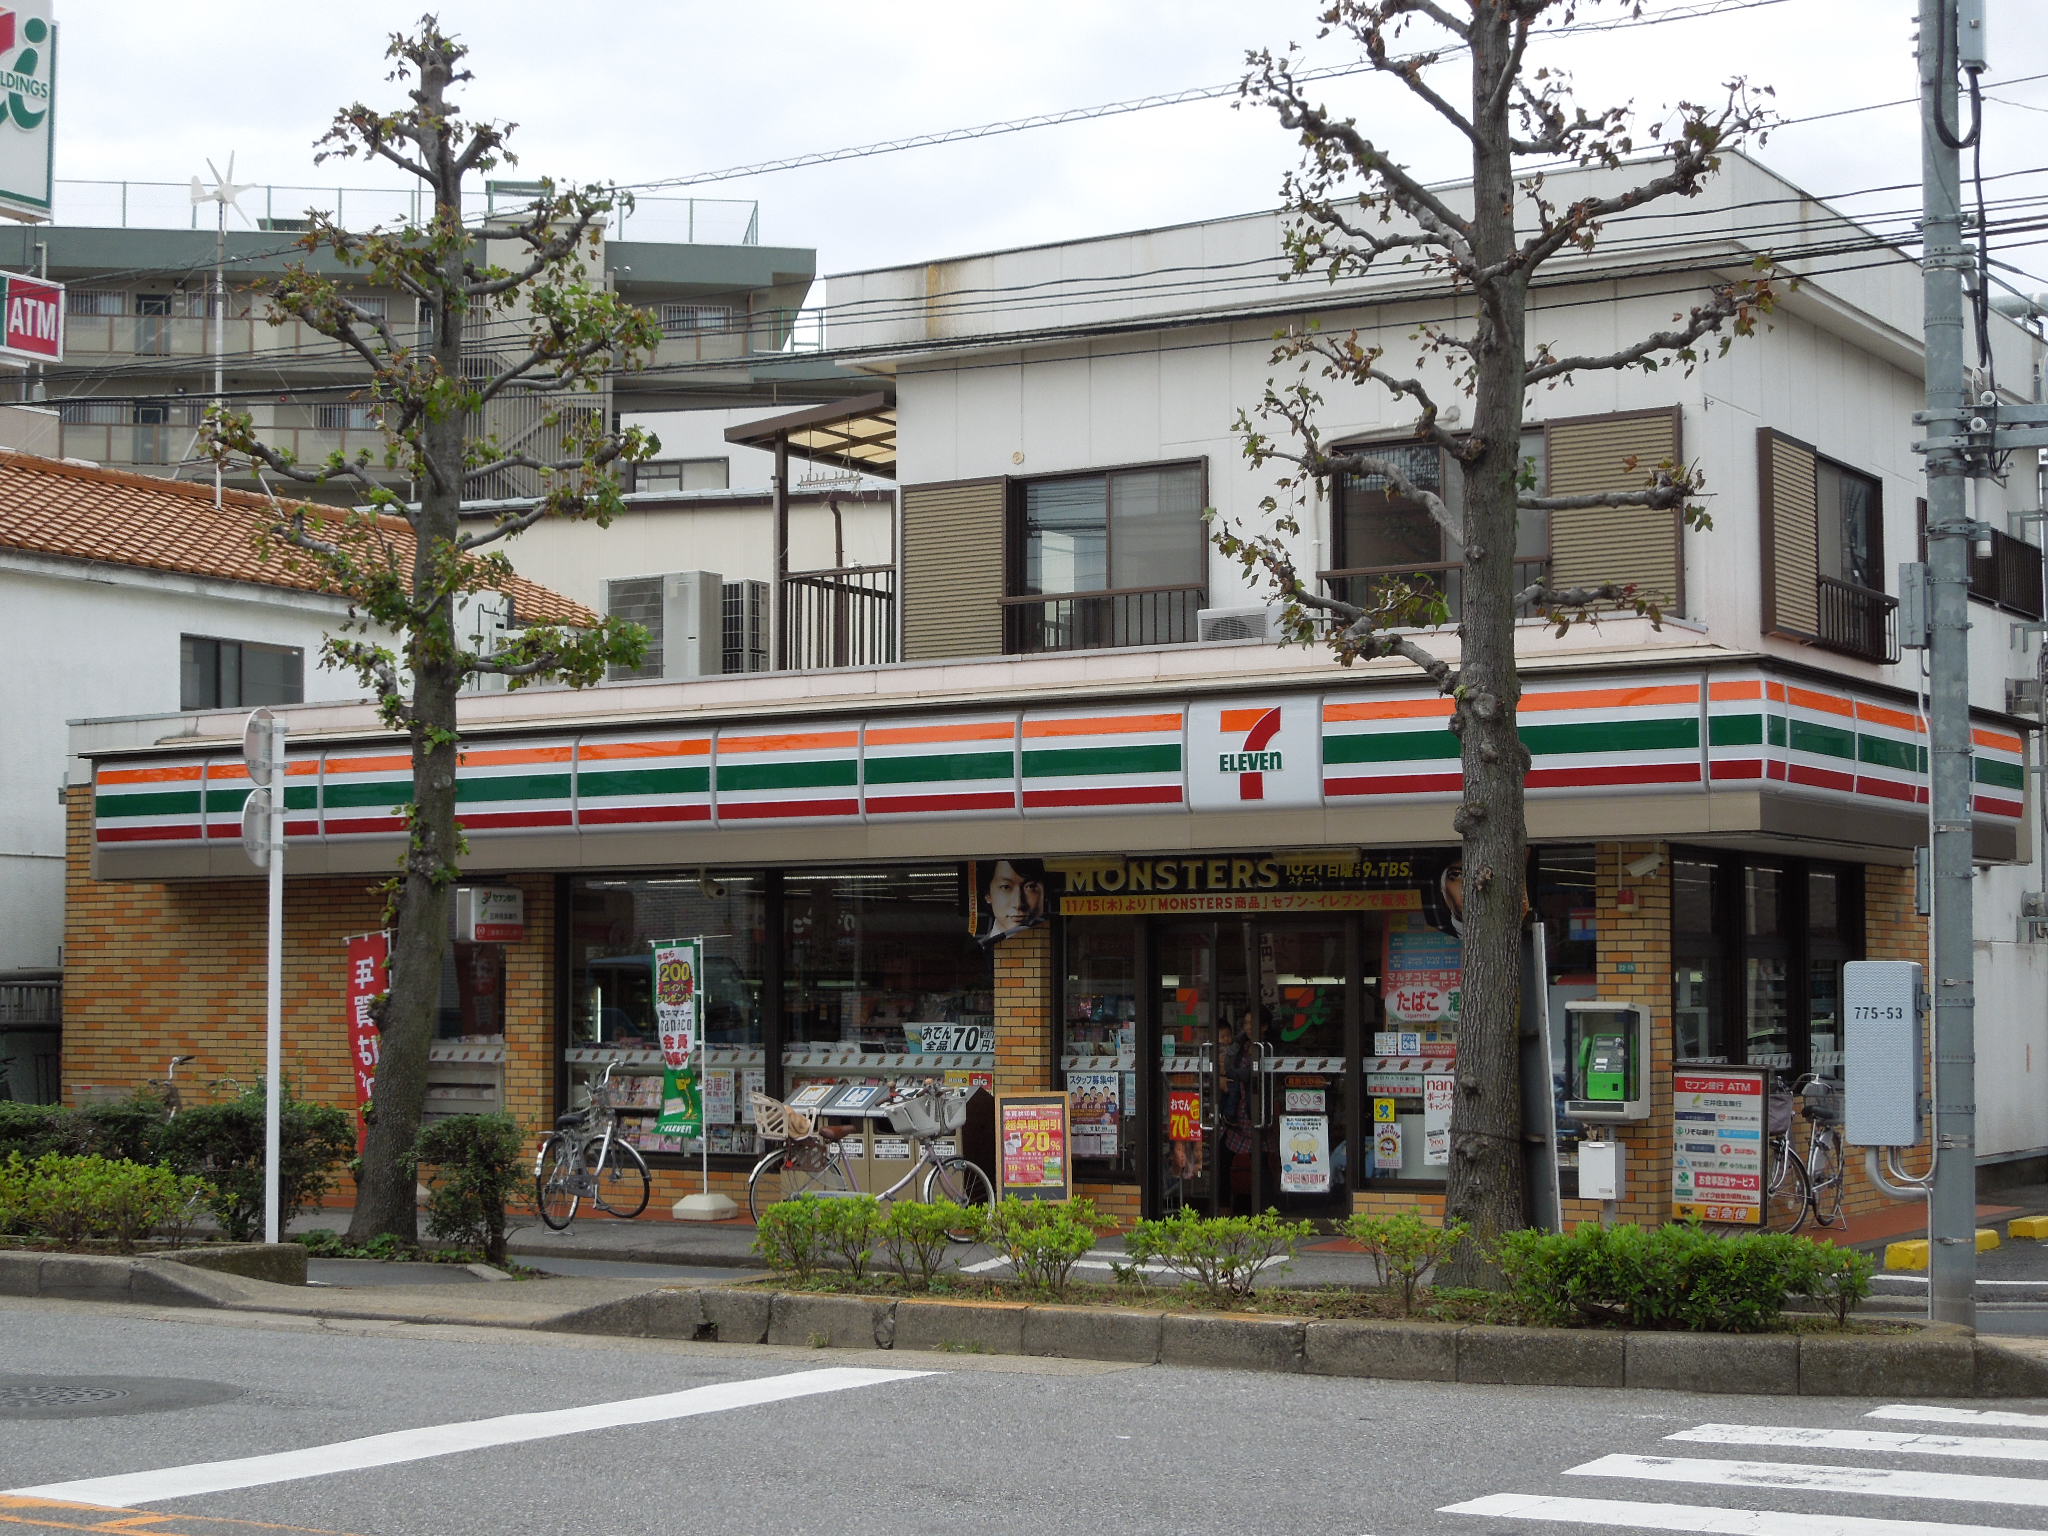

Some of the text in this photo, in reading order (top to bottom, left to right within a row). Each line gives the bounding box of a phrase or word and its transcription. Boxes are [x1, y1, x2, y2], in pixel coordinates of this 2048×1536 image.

[0, 71, 48, 98] LDINGS
[8, 296, 57, 342] ATM
[1220, 706, 1281, 800] 7
[1064, 859, 1280, 892] MONSTERS
[660, 961, 691, 982] 200
[663, 983, 688, 992] ポイント
[1396, 990, 1439, 1011] たばこ
[1853, 1006, 1903, 1020] 775-53
[922, 1026, 950, 1041] おでん
[953, 1026, 979, 1051] 70
[663, 1033, 688, 1050] 会員
[924, 1040, 948, 1051] 全品
[705, 1078, 730, 1091] お届け
[1427, 1079, 1453, 1091] nan
[1684, 1080, 1751, 1091] セブン銀行 ATM
[1170, 1099, 1190, 1111] おでん
[1429, 1102, 1451, 1110] キャンペ
[1005, 1119, 1061, 1130] 超早期割引
[1685, 1128, 1715, 1137] りそな銀行
[1022, 1131, 1061, 1152] 20%
[1706, 1205, 1747, 1220] 宅急便
